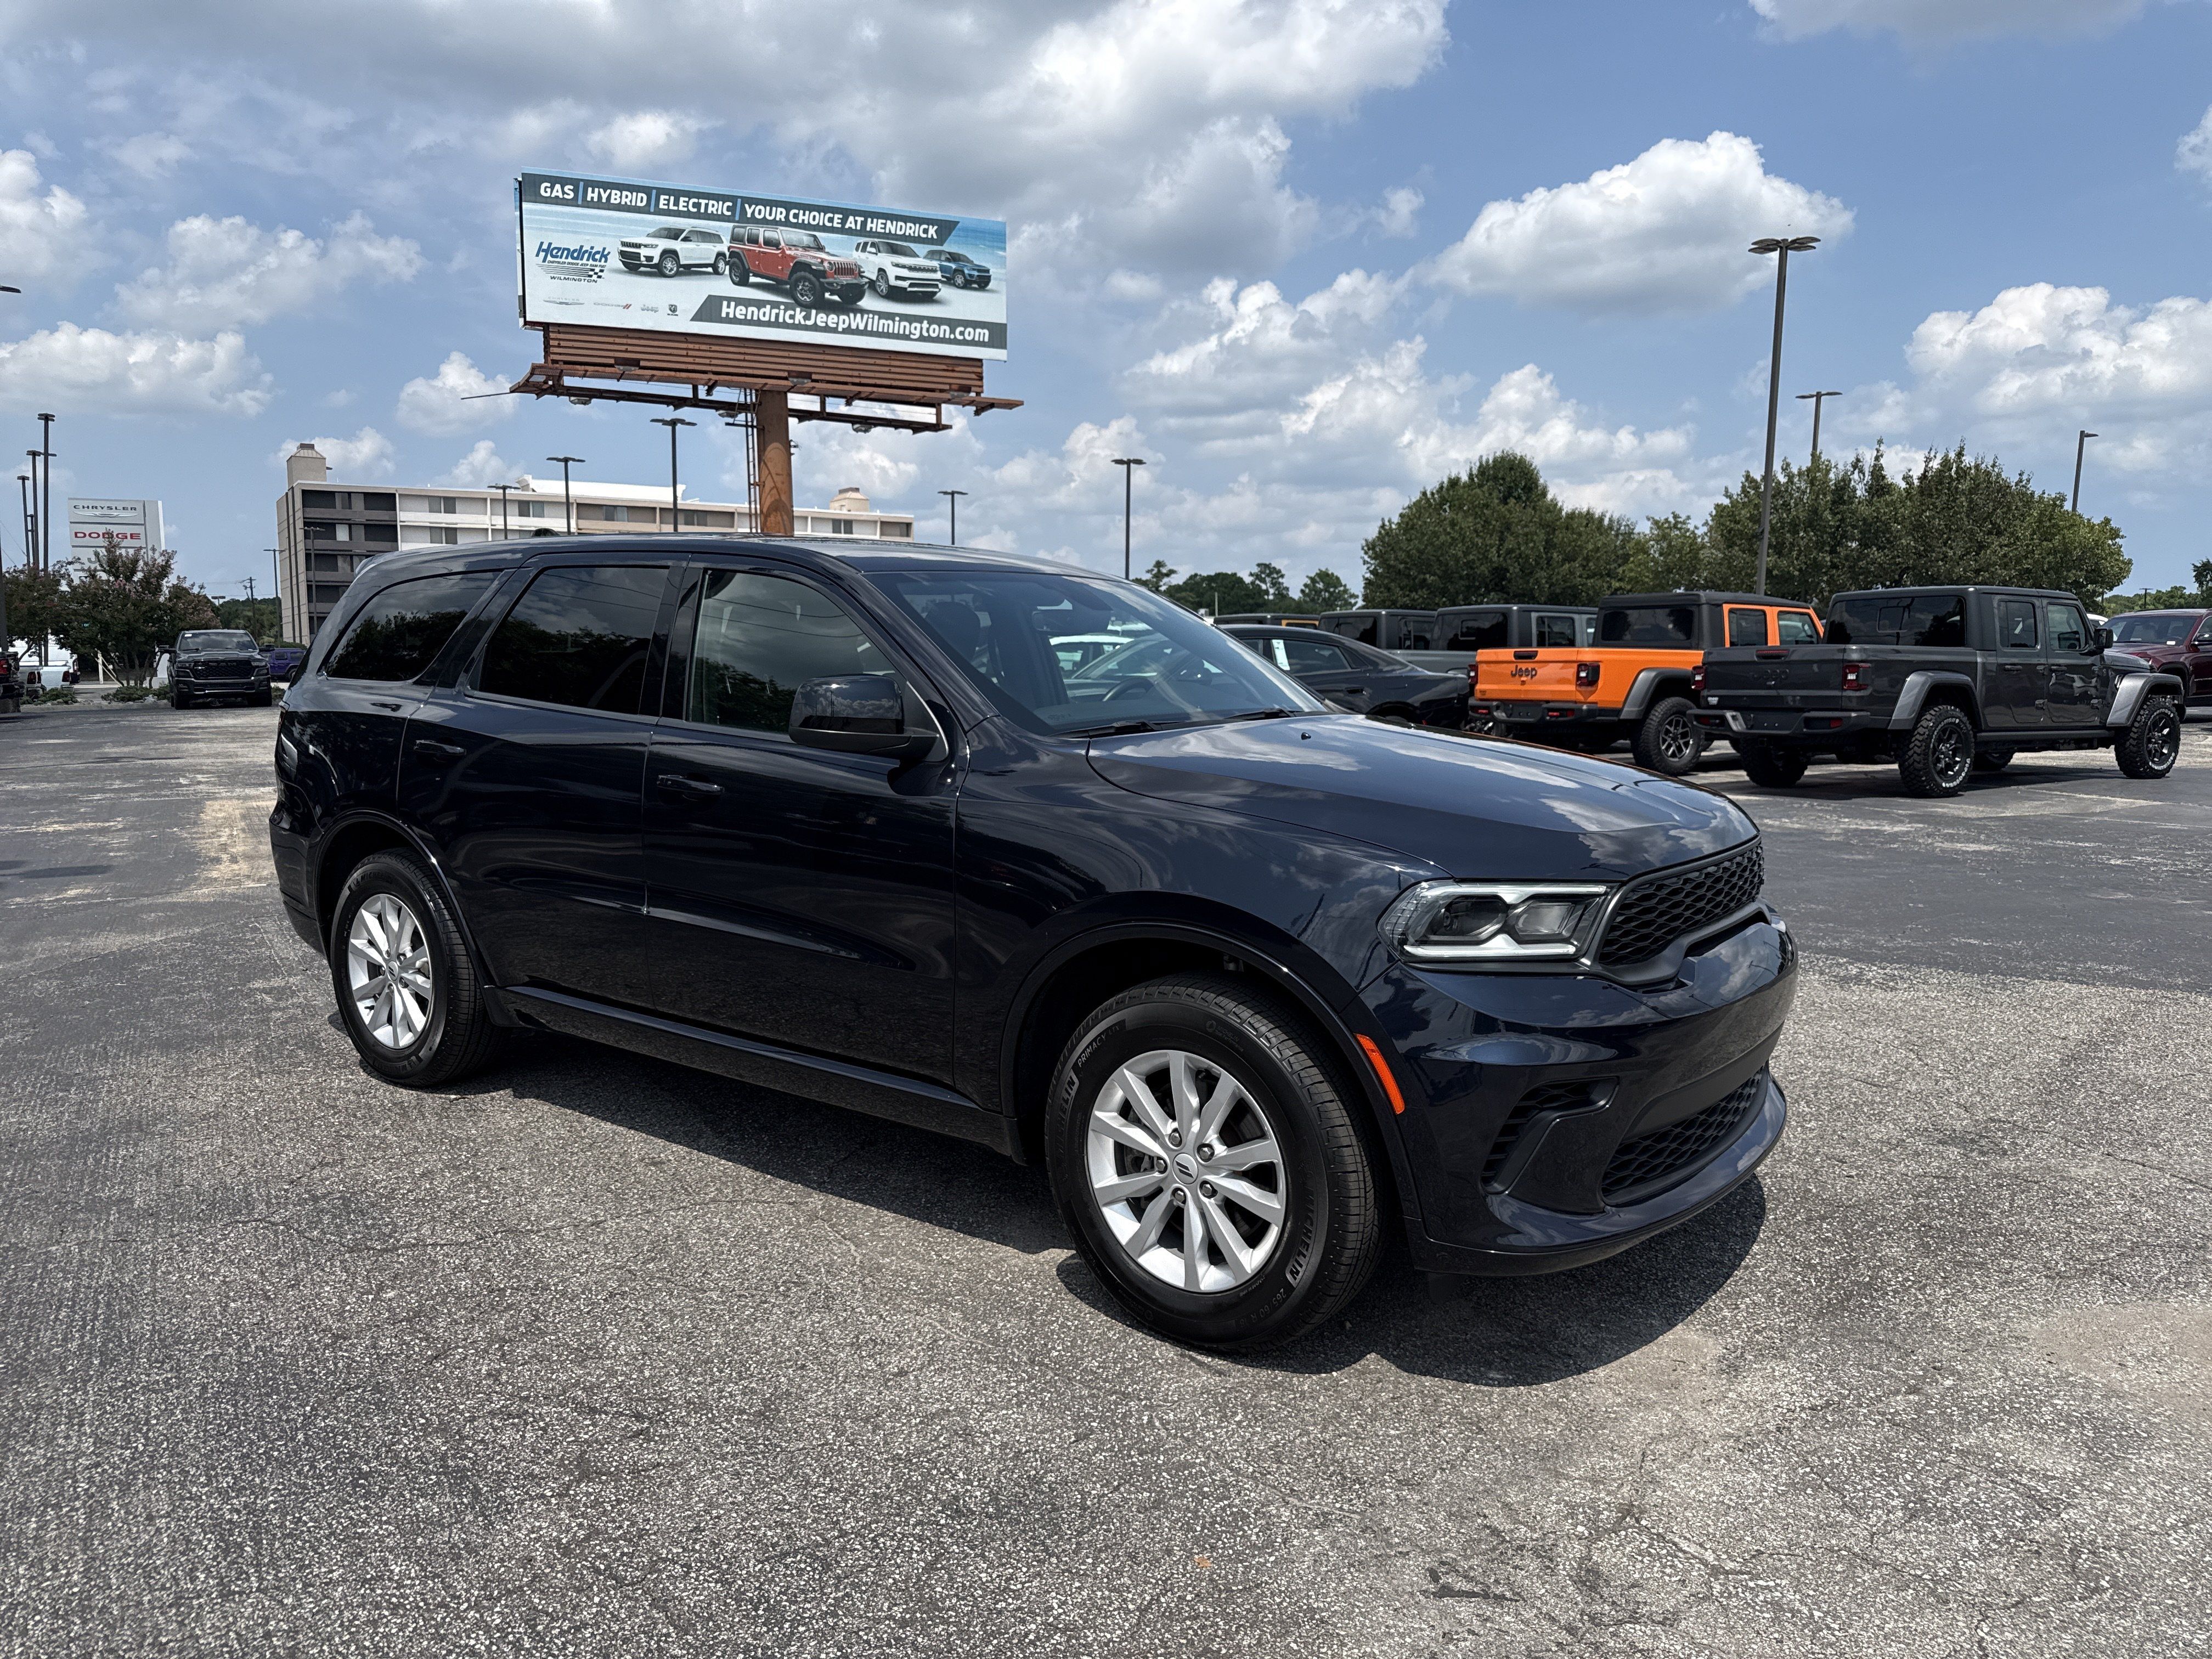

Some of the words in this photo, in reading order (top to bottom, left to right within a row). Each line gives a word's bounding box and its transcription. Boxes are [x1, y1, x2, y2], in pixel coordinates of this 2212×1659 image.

[540, 182, 574, 199] GAS
[586, 187, 647, 207] HYBRID
[659, 195, 733, 216] ELECTRIC
[744, 204, 786, 222] YOUR
[789, 208, 842, 228] CHOICE
[846, 215, 865, 230] AT
[866, 218, 938, 239] HENDRICK
[535, 241, 611, 263] Hendrick
[721, 300, 989, 342] HendrickJeepWilmington.com
[74, 532, 141, 540] DODGE
[1511, 664, 1537, 679] Jeep
[1077, 1034, 1106, 1068] PRIMACY
[1108, 1025, 1120, 1036] LTX
